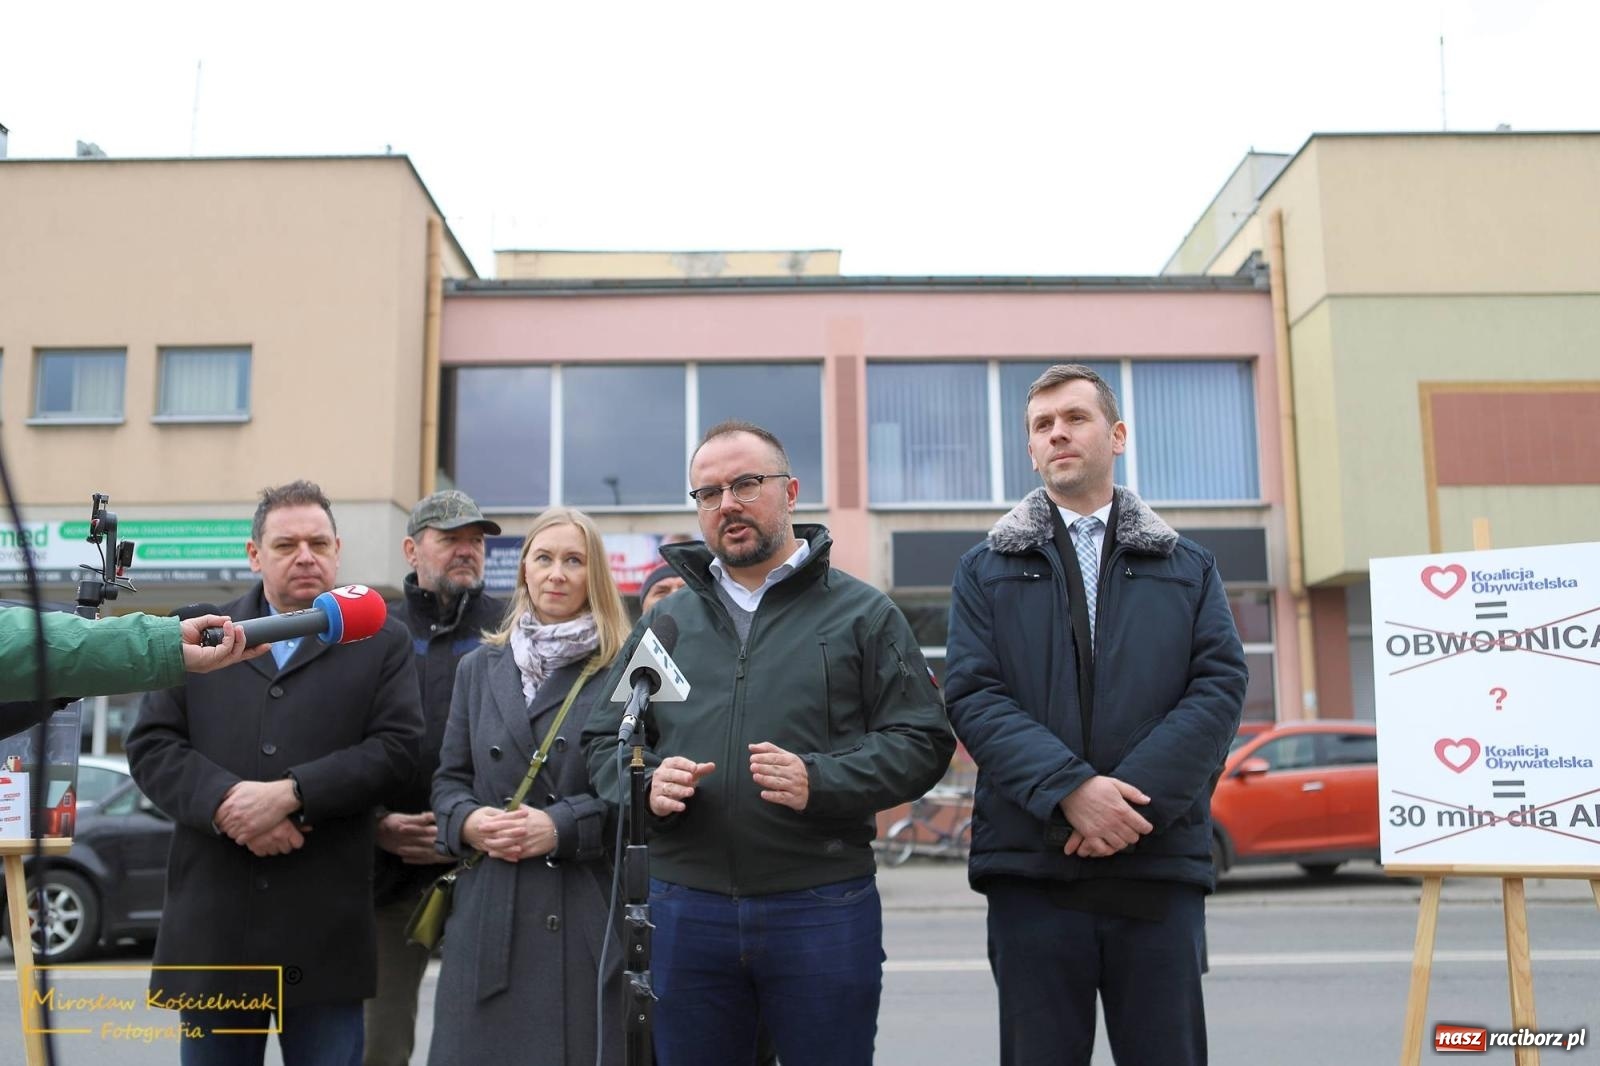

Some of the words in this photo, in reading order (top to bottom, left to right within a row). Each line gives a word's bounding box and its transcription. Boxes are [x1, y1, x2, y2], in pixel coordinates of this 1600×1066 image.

[1471, 567, 1535, 582] Koalicja
[1471, 577, 1578, 595] Obywatelska
[1489, 687, 1508, 710] ?
[1485, 745, 1549, 759] Koalicja
[1485, 757, 1593, 771] Obywatelska
[1389, 805, 1426, 827] 30
[1437, 805, 1496, 827] mln
[1508, 805, 1558, 827] dla
[1569, 804, 1600, 827] A
